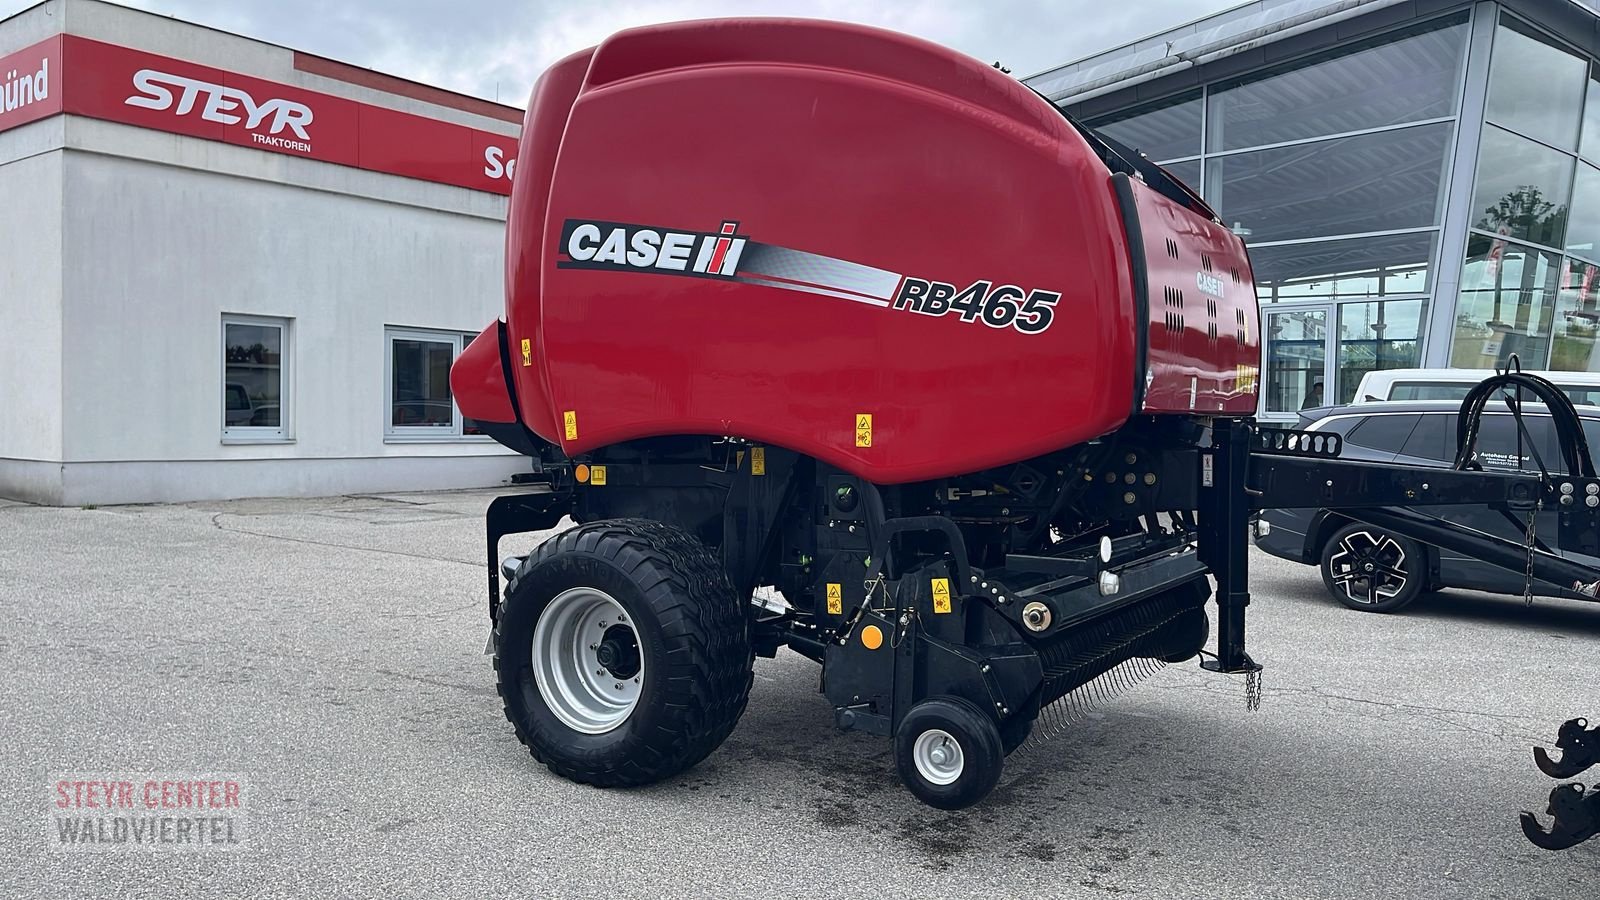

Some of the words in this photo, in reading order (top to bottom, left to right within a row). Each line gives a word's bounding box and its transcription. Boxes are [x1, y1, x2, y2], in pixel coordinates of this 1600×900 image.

[0, 57, 48, 114] ünd
[124, 69, 314, 141] STEYR
[252, 132, 311, 153] TRAKTOREN
[568, 224, 697, 271] CASE
[892, 276, 1063, 335] RB465
[1196, 271, 1218, 297] CASE
[1480, 451, 1508, 460] Autohaus
